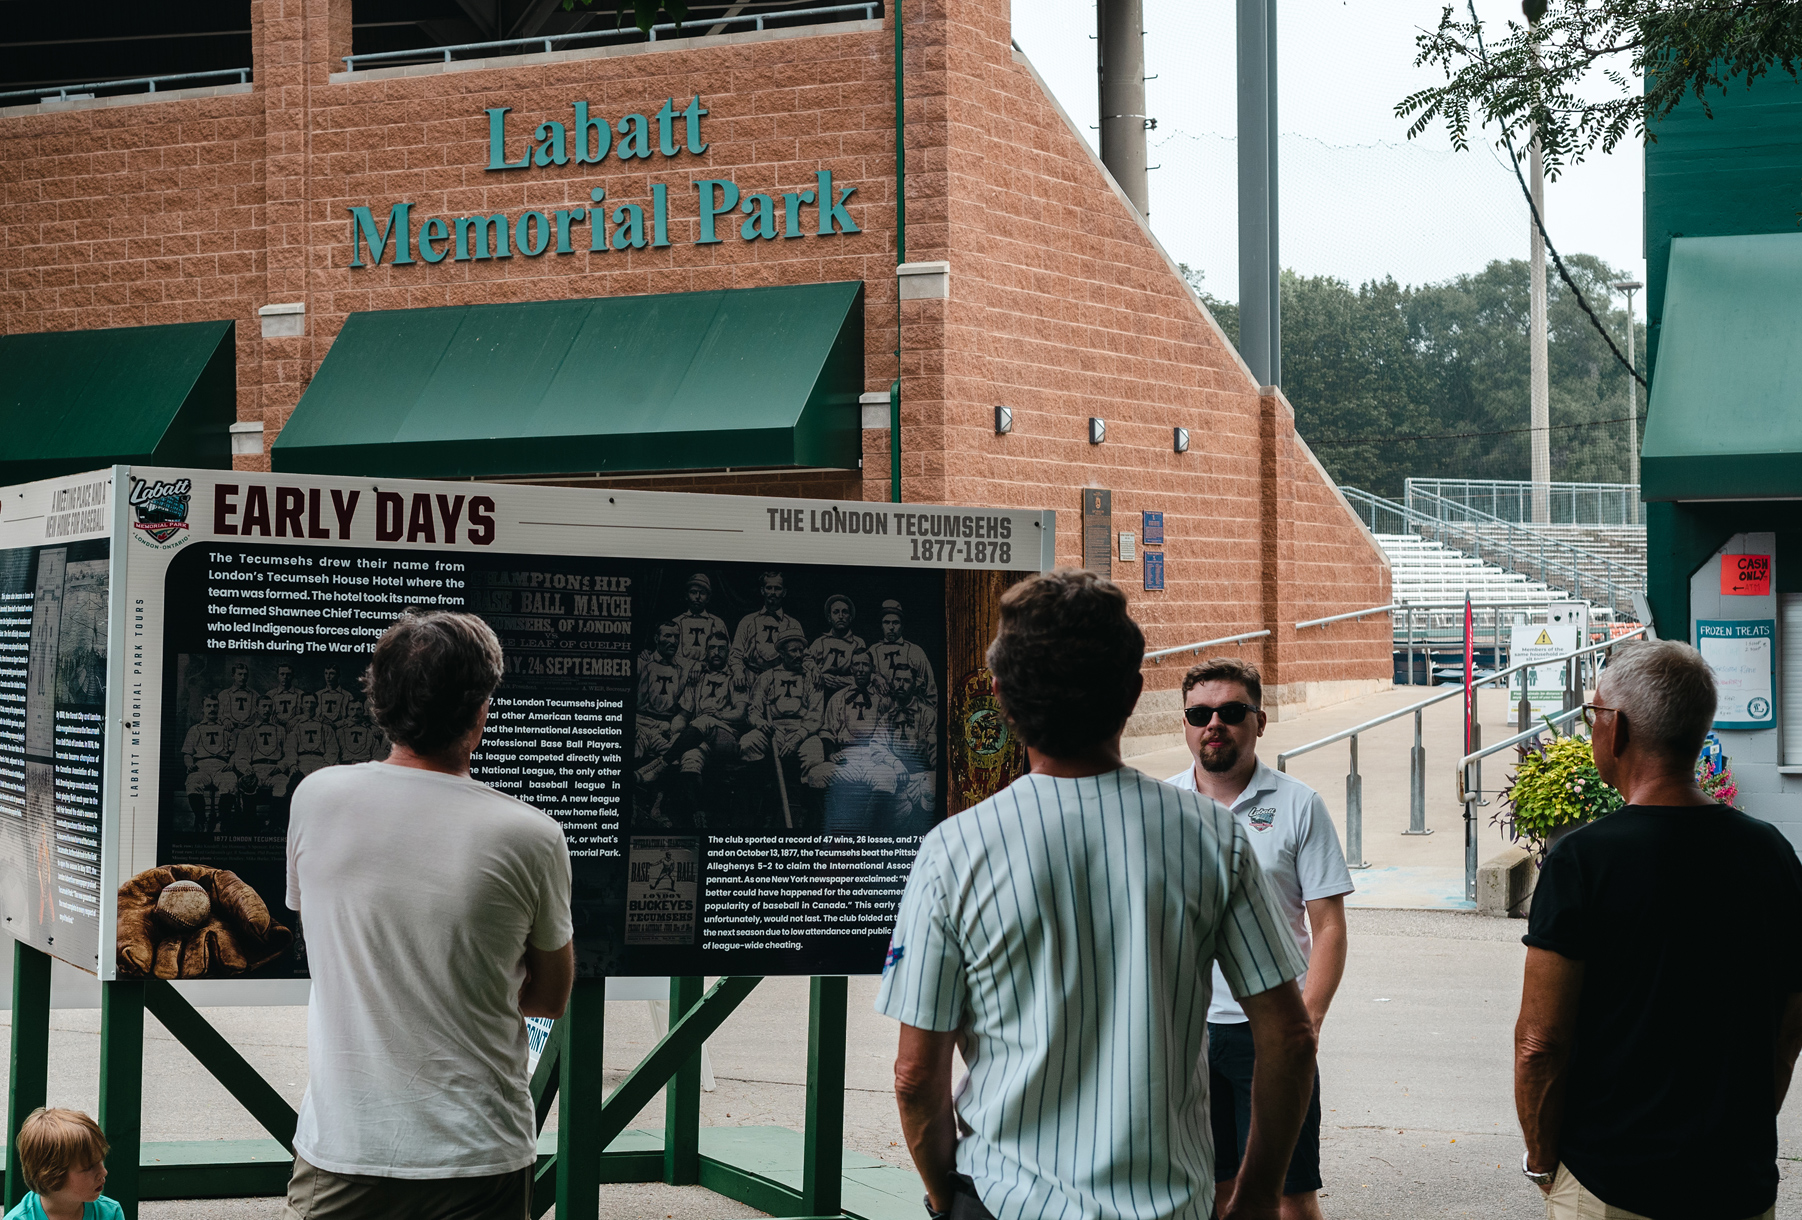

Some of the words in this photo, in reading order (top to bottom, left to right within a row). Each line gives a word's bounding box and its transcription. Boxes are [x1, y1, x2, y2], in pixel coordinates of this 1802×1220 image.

[484, 94, 709, 171] Labatt
[347, 184, 671, 268] Memorial
[693, 170, 862, 244] Park
[51, 491, 56, 513] A
[56, 487, 76, 512] MEETING
[76, 484, 91, 509] PLACE
[91, 482, 102, 506] AND
[102, 481, 106, 504] A
[130, 479, 191, 504] Labatt
[45, 515, 57, 538] NEW
[56, 513, 71, 537] HOME
[70, 511, 80, 535] FOR
[80, 507, 105, 533] BASEBALL
[213, 484, 360, 541] EARLY
[376, 491, 496, 545] DAYS
[169, 521, 187, 529] PARK
[767, 508, 804, 532] THE
[810, 509, 888, 535] LONDON
[894, 513, 1012, 540] TECUMSEHS
[134, 534, 159, 549] LONDON
[162, 536, 189, 550] ONTARIO
[910, 538, 1012, 564] 1877-1878
[209, 552, 233, 563] The
[239, 554, 313, 566] Tecumsehs
[319, 557, 351, 567] drew
[357, 558, 387, 569] their
[393, 561, 429, 570] name
[435, 560, 465, 572] from
[1738, 558, 1768, 570] CASH
[267, 572, 329, 583] Tecumseh
[333, 574, 370, 585] House
[373, 576, 403, 586] Hotel
[406, 577, 443, 587] where
[445, 578, 465, 588] the
[1739, 570, 1766, 581] ONLY
[1745, 583, 1760, 592] ATM
[208, 587, 239, 597] team
[240, 590, 264, 598] was
[265, 588, 310, 600] formed.
[311, 590, 332, 601] The
[334, 591, 362, 602] hotel
[363, 592, 388, 602] took
[389, 592, 403, 603] its
[404, 595, 437, 604] name
[438, 594, 464, 605] from
[470, 590, 512, 613] BASE
[520, 591, 565, 614] BALL
[573, 594, 632, 618] MATCH
[135, 599, 144, 636] TOURS
[208, 604, 227, 614] the
[228, 604, 267, 616] famed
[268, 606, 321, 617] Shawnee
[322, 608, 352, 618] Chief
[207, 621, 232, 632] who
[233, 622, 251, 632] led
[252, 622, 314, 636] Indigenous
[315, 624, 350, 635] forces
[351, 626, 392, 639] alongs
[558, 619, 575, 633] OF
[578, 619, 632, 635] LONDON
[1700, 625, 1732, 636] FROZEN
[1735, 625, 1770, 636] TREATS
[207, 638, 226, 648] the
[228, 639, 265, 650] British
[266, 640, 304, 654] during
[306, 641, 327, 652] The
[328, 642, 353, 652] War
[353, 642, 365, 653] of
[559, 640, 576, 649] OF
[579, 641, 632, 651] GUELPH
[134, 644, 143, 674] PARK
[546, 656, 631, 677] SEPTEMBER
[497, 697, 512, 706] the
[513, 698, 545, 706] London
[546, 699, 595, 708] Tecumsehs
[596, 699, 623, 710] joined
[132, 682, 142, 746] MEMORIAL
[501, 711, 526, 720] other
[528, 712, 571, 721] American
[574, 713, 602, 721] teams
[498, 725, 513, 733] the
[514, 725, 571, 734] International
[572, 726, 622, 735] Association
[482, 738, 537, 747] Professional
[541, 740, 563, 748] Base
[566, 740, 583, 748] Ball
[587, 740, 622, 751] Players.
[486, 752, 517, 763] league
[519, 753, 564, 763] competed
[566, 753, 600, 764] directly
[602, 753, 621, 762] with
[130, 753, 140, 797] LABATT
[482, 766, 520, 774] National
[522, 767, 556, 777] League,
[559, 767, 574, 775] the
[576, 767, 595, 778] only
[597, 768, 621, 776] other
[229, 835, 252, 843] LONDON
[708, 835, 724, 843] The
[725, 835, 744, 843] club
[745, 835, 777, 845] sported
[813, 835, 822, 843] of
[823, 835, 833, 843] 47
[834, 835, 855, 844] wins,
[856, 835, 866, 843] 26
[867, 835, 895, 844] losses,
[896, 835, 912, 843] and
[913, 835, 918, 843] 7
[707, 849, 724, 857] and
[736, 849, 770, 857] October
[770, 849, 780, 857] 13,
[781, 849, 799, 857] 1877,
[800, 849, 814, 857] the
[814, 849, 860, 857] Tecumsehs
[894, 849, 918, 857] Pittsb
[631, 862, 650, 882] BASE
[629, 900, 693, 911] BUCKEYES
[704, 901, 750, 912] popularity
[752, 901, 761, 910] of
[763, 901, 799, 909] baseball
[801, 901, 810, 909] in
[854, 900, 872, 909] This
[874, 901, 896, 911] early
[629, 913, 693, 922] TECUMSEHS
[702, 942, 711, 950] of
[712, 941, 764, 952] league-wide
[765, 940, 803, 951] cheating.
